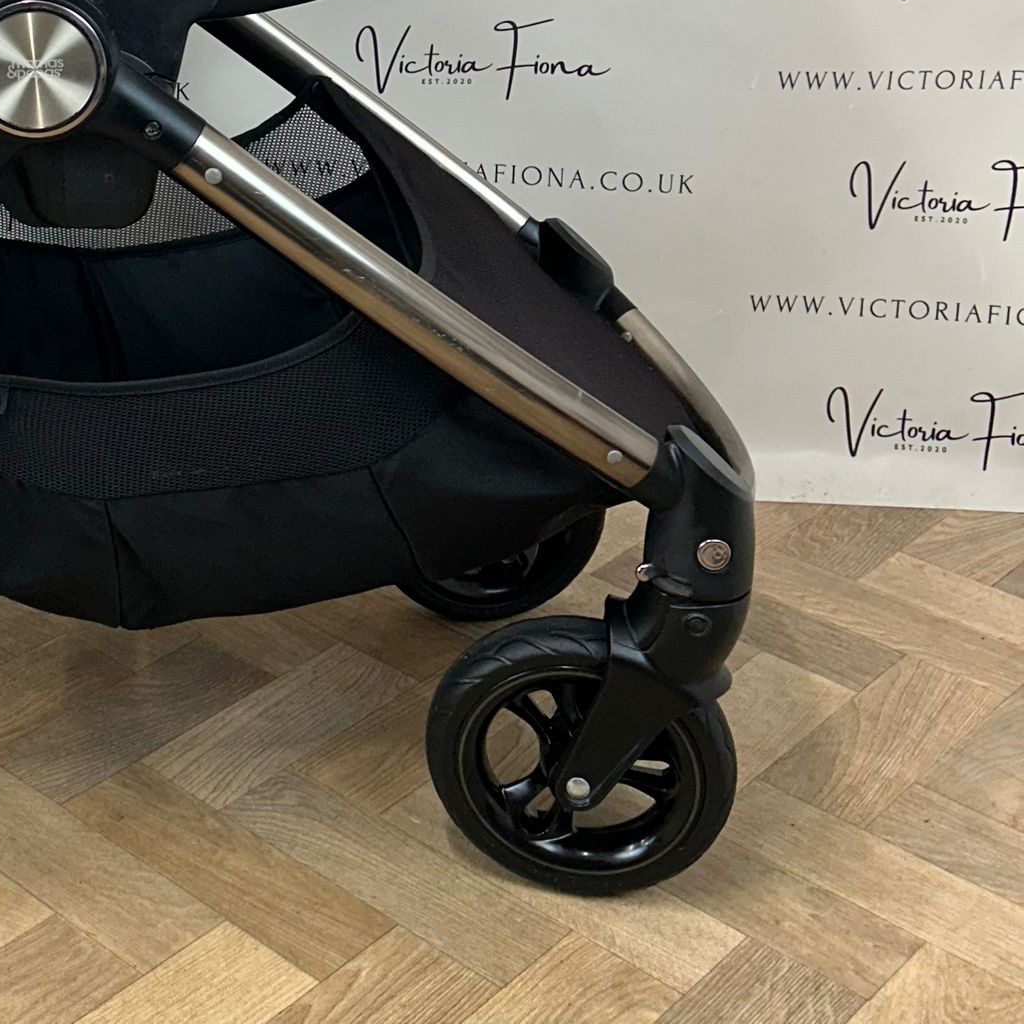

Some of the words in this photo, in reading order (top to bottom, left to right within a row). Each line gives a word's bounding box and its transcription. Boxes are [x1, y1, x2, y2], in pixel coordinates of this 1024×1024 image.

[353, 24, 494, 95] Victoria
[490, 17, 612, 101] Fiona
[421, 77, 473, 86] EST.2020
[848, 160, 995, 231] Victoria
[913, 215, 969, 225] EST.2020
[826, 385, 973, 458] Victoria
[893, 442, 948, 454] EST.2020
